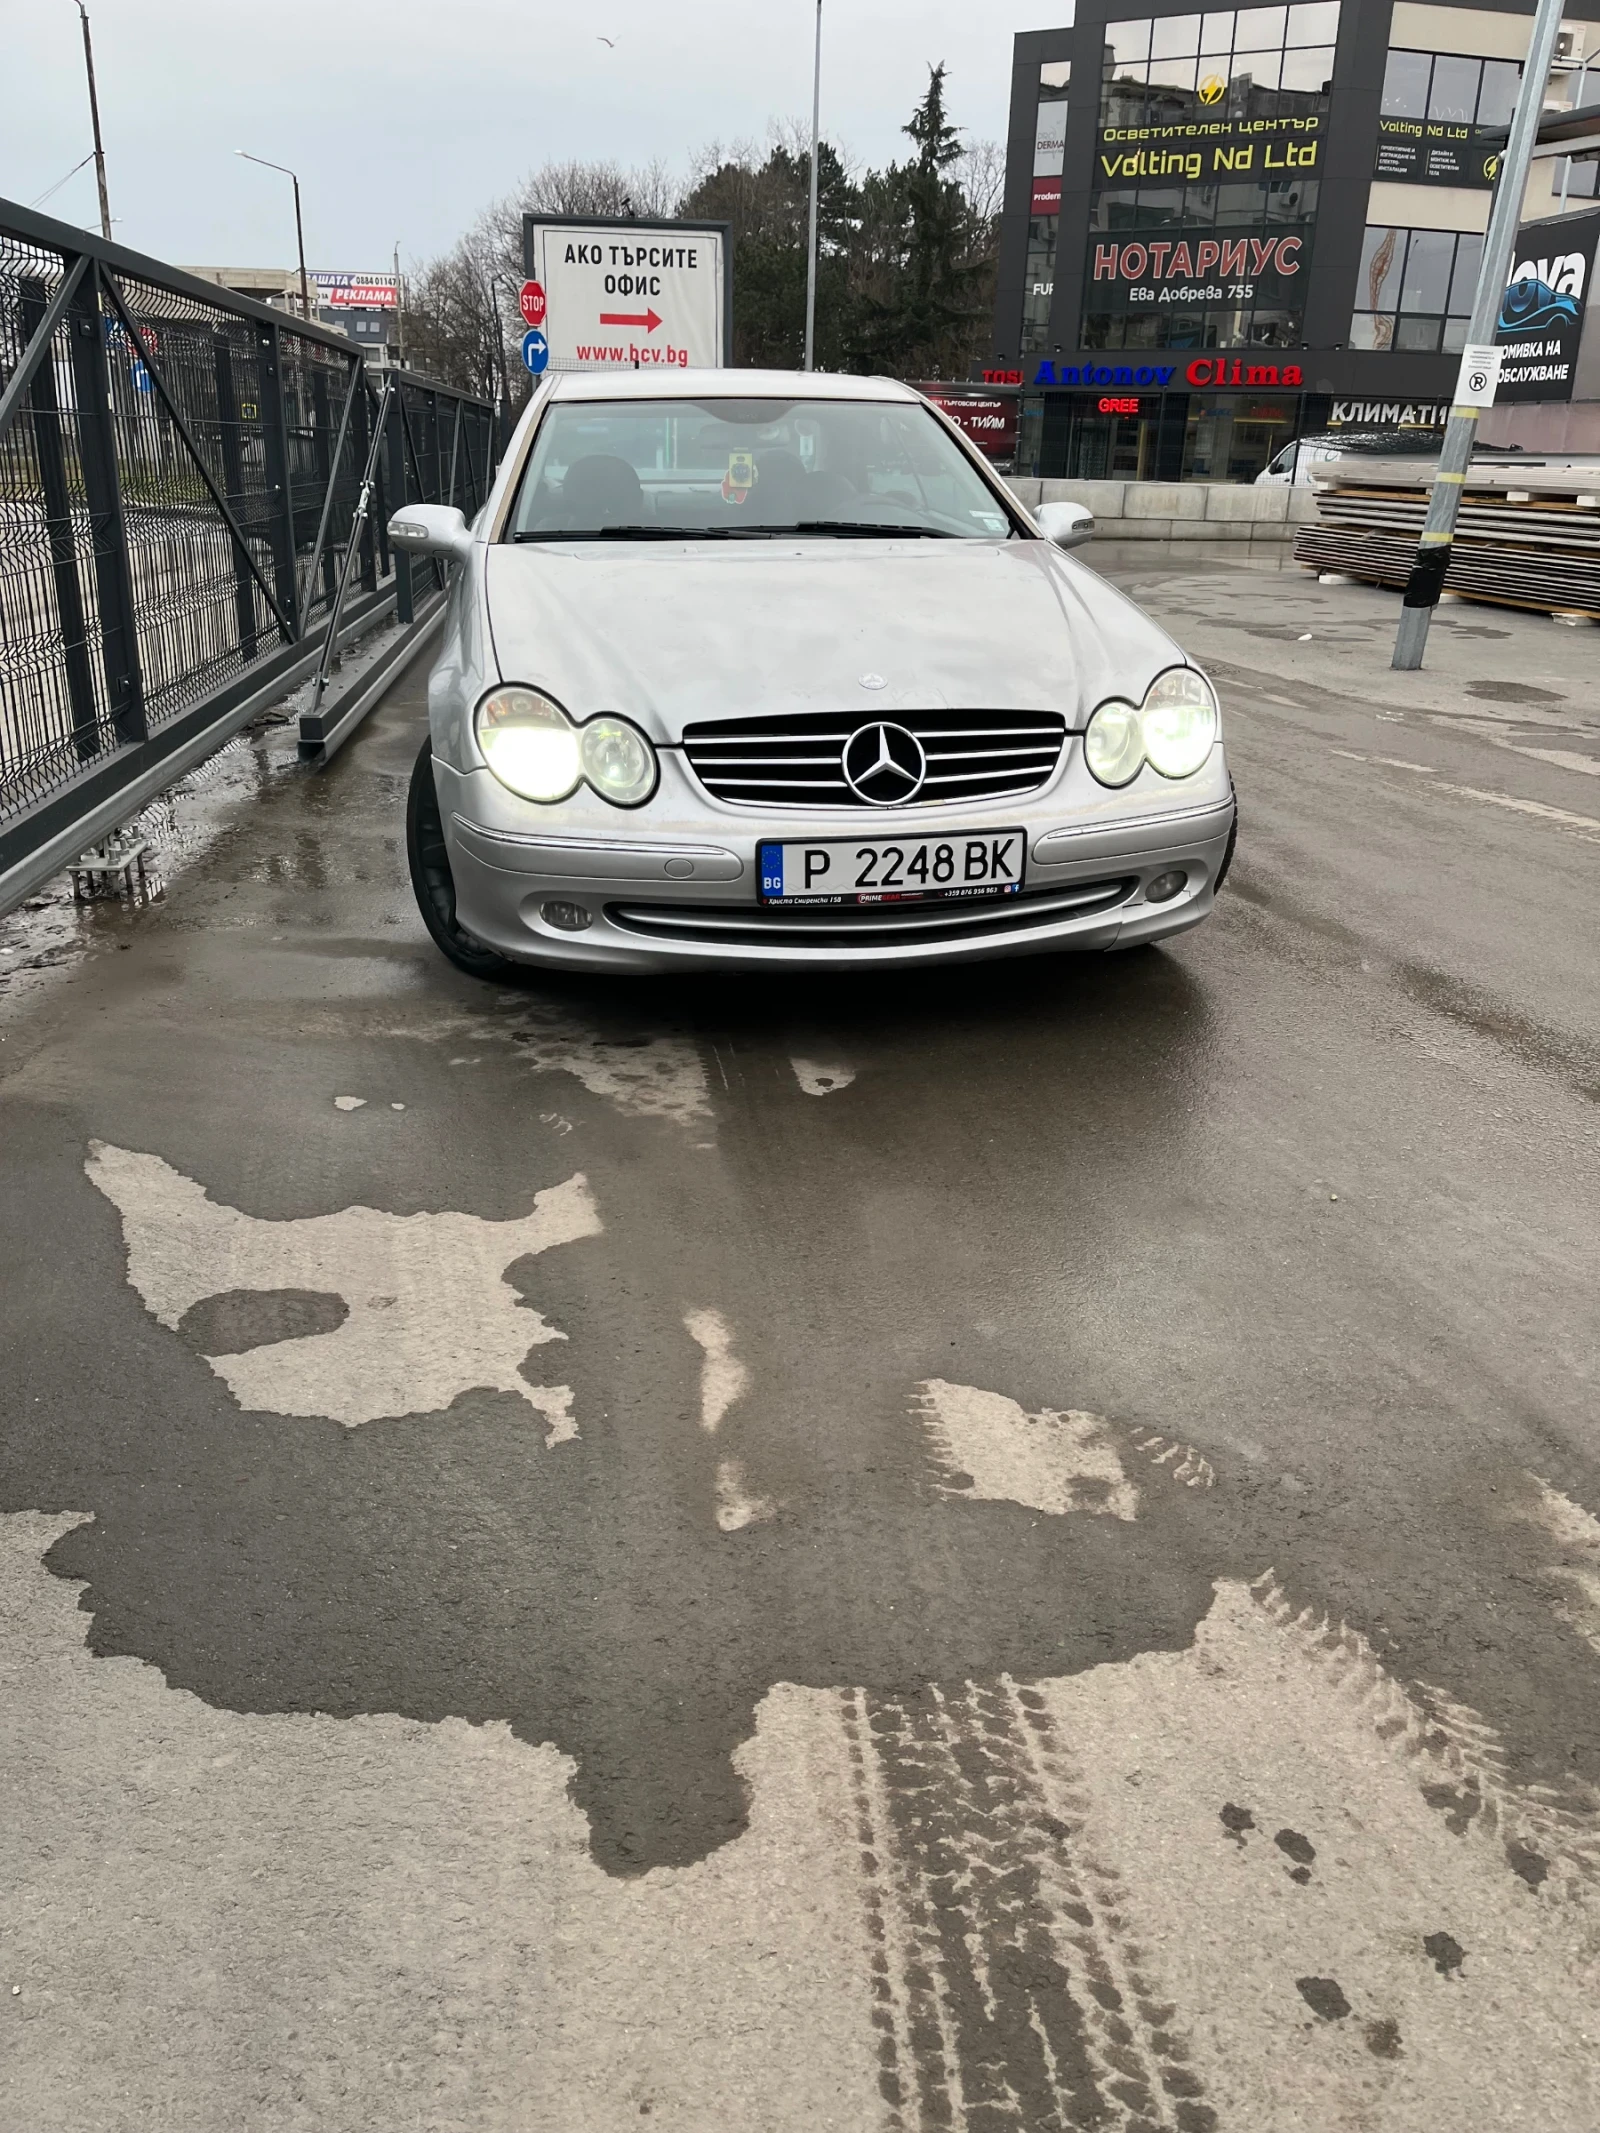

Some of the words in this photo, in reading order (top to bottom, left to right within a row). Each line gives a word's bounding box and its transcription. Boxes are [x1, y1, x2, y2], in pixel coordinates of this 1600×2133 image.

[1103, 120, 1232, 142] Осветителен
[1239, 116, 1319, 135] център
[1379, 120, 1422, 138] Volting
[1427, 125, 1444, 137] Nd
[1447, 127, 1468, 139] Ltd
[1036, 139, 1065, 150] DERMA
[1101, 148, 1202, 179] Volting
[1213, 144, 1253, 171] Nd
[1264, 140, 1318, 168] Ltd
[564, 244, 602, 265] АКО
[609, 246, 698, 268] ТЪРСИТЕ
[1093, 236, 1303, 281] НОТАРИУС
[604, 274, 661, 296] ОФИС
[1129, 287, 1155, 301] Ева
[1158, 285, 1222, 303] Добрева
[1227, 284, 1253, 299] 755
[336, 289, 393, 302] РЕКЛАМА
[522, 294, 544, 311] STOP
[577, 343, 688, 367] www.bcv.bg
[1545, 340, 1561, 356] НА
[1033, 360, 1176, 386] Antonov
[1186, 358, 1304, 387] Clima
[943, 400, 977, 408] ТЪРГОВСКИ
[977, 401, 1002, 409] ЦЕНТЪР
[1098, 397, 1139, 413] GREE
[970, 414, 1005, 430] ТИЙМ
[804, 849, 831, 889] P
[855, 843, 954, 888] 2248
[964, 838, 1015, 881] BK
[763, 877, 782, 889] BG
